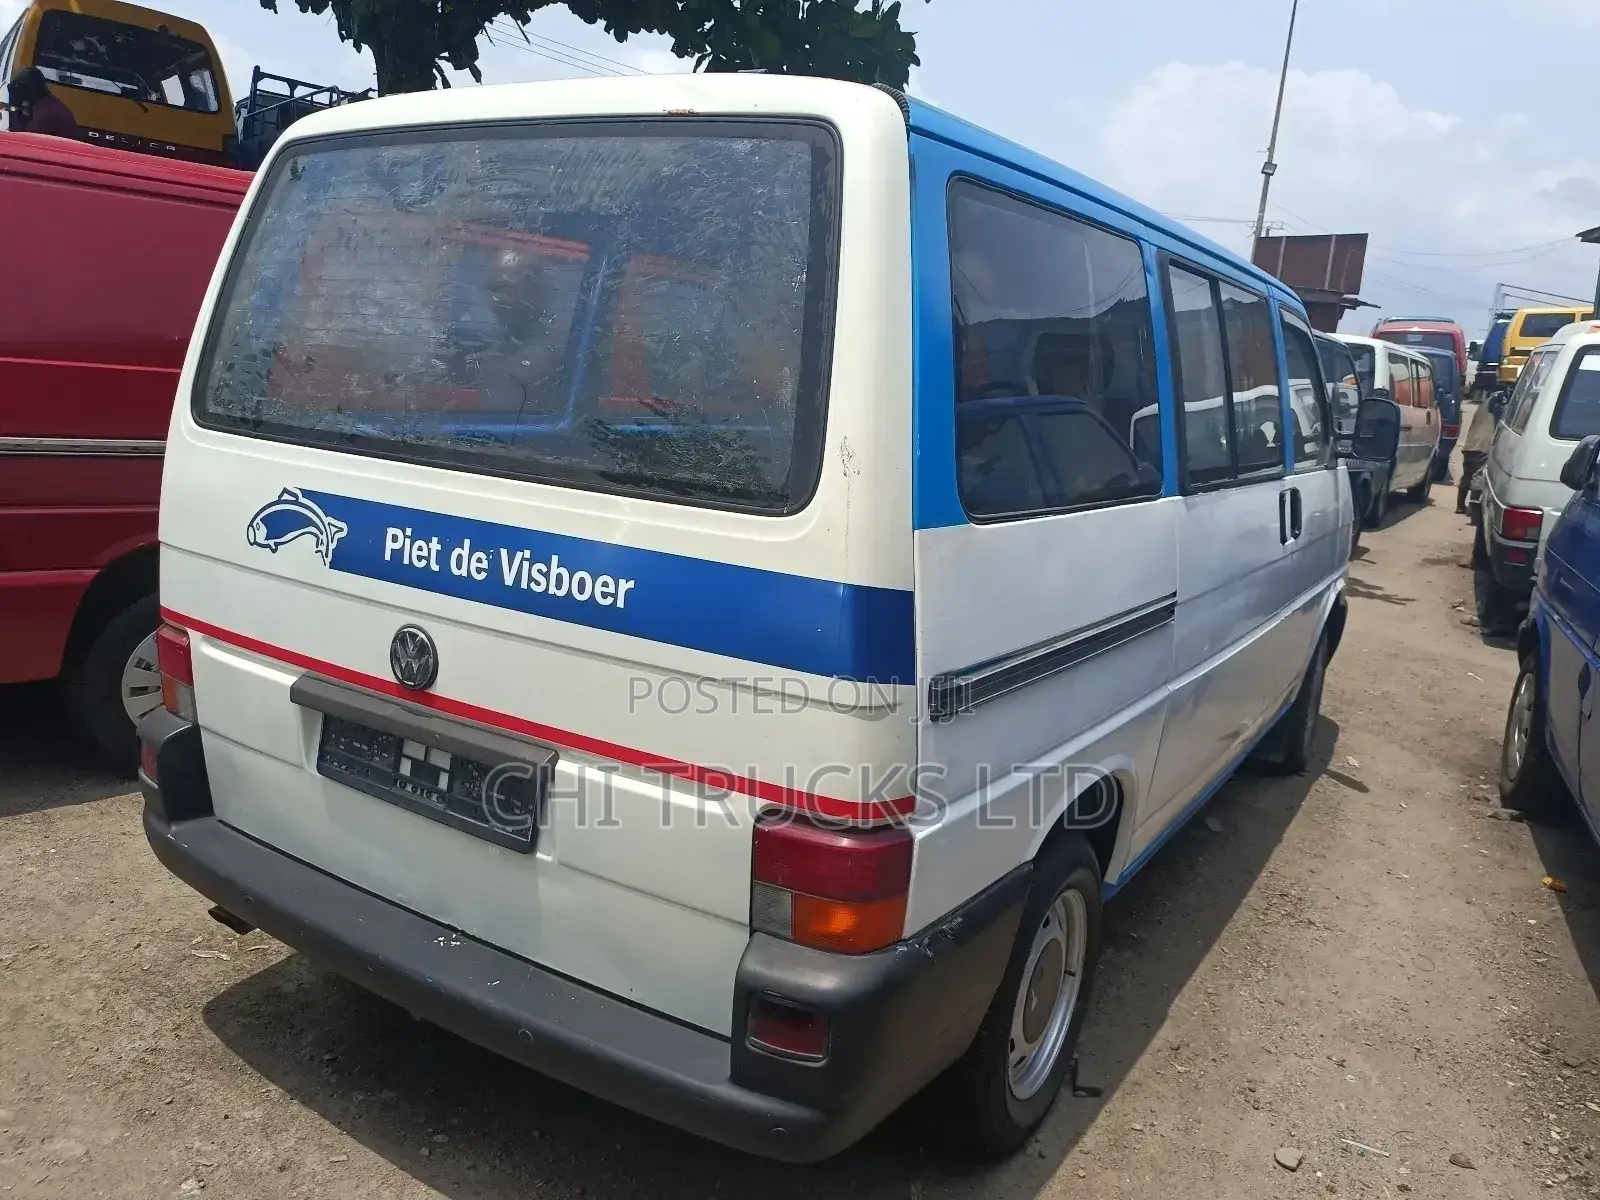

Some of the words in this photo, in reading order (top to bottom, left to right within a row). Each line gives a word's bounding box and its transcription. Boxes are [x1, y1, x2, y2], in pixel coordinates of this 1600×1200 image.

[88, 131, 176, 151] DELICA
[384, 527, 442, 572] Piet
[450, 538, 489, 581] de
[500, 547, 635, 609] Visboer
